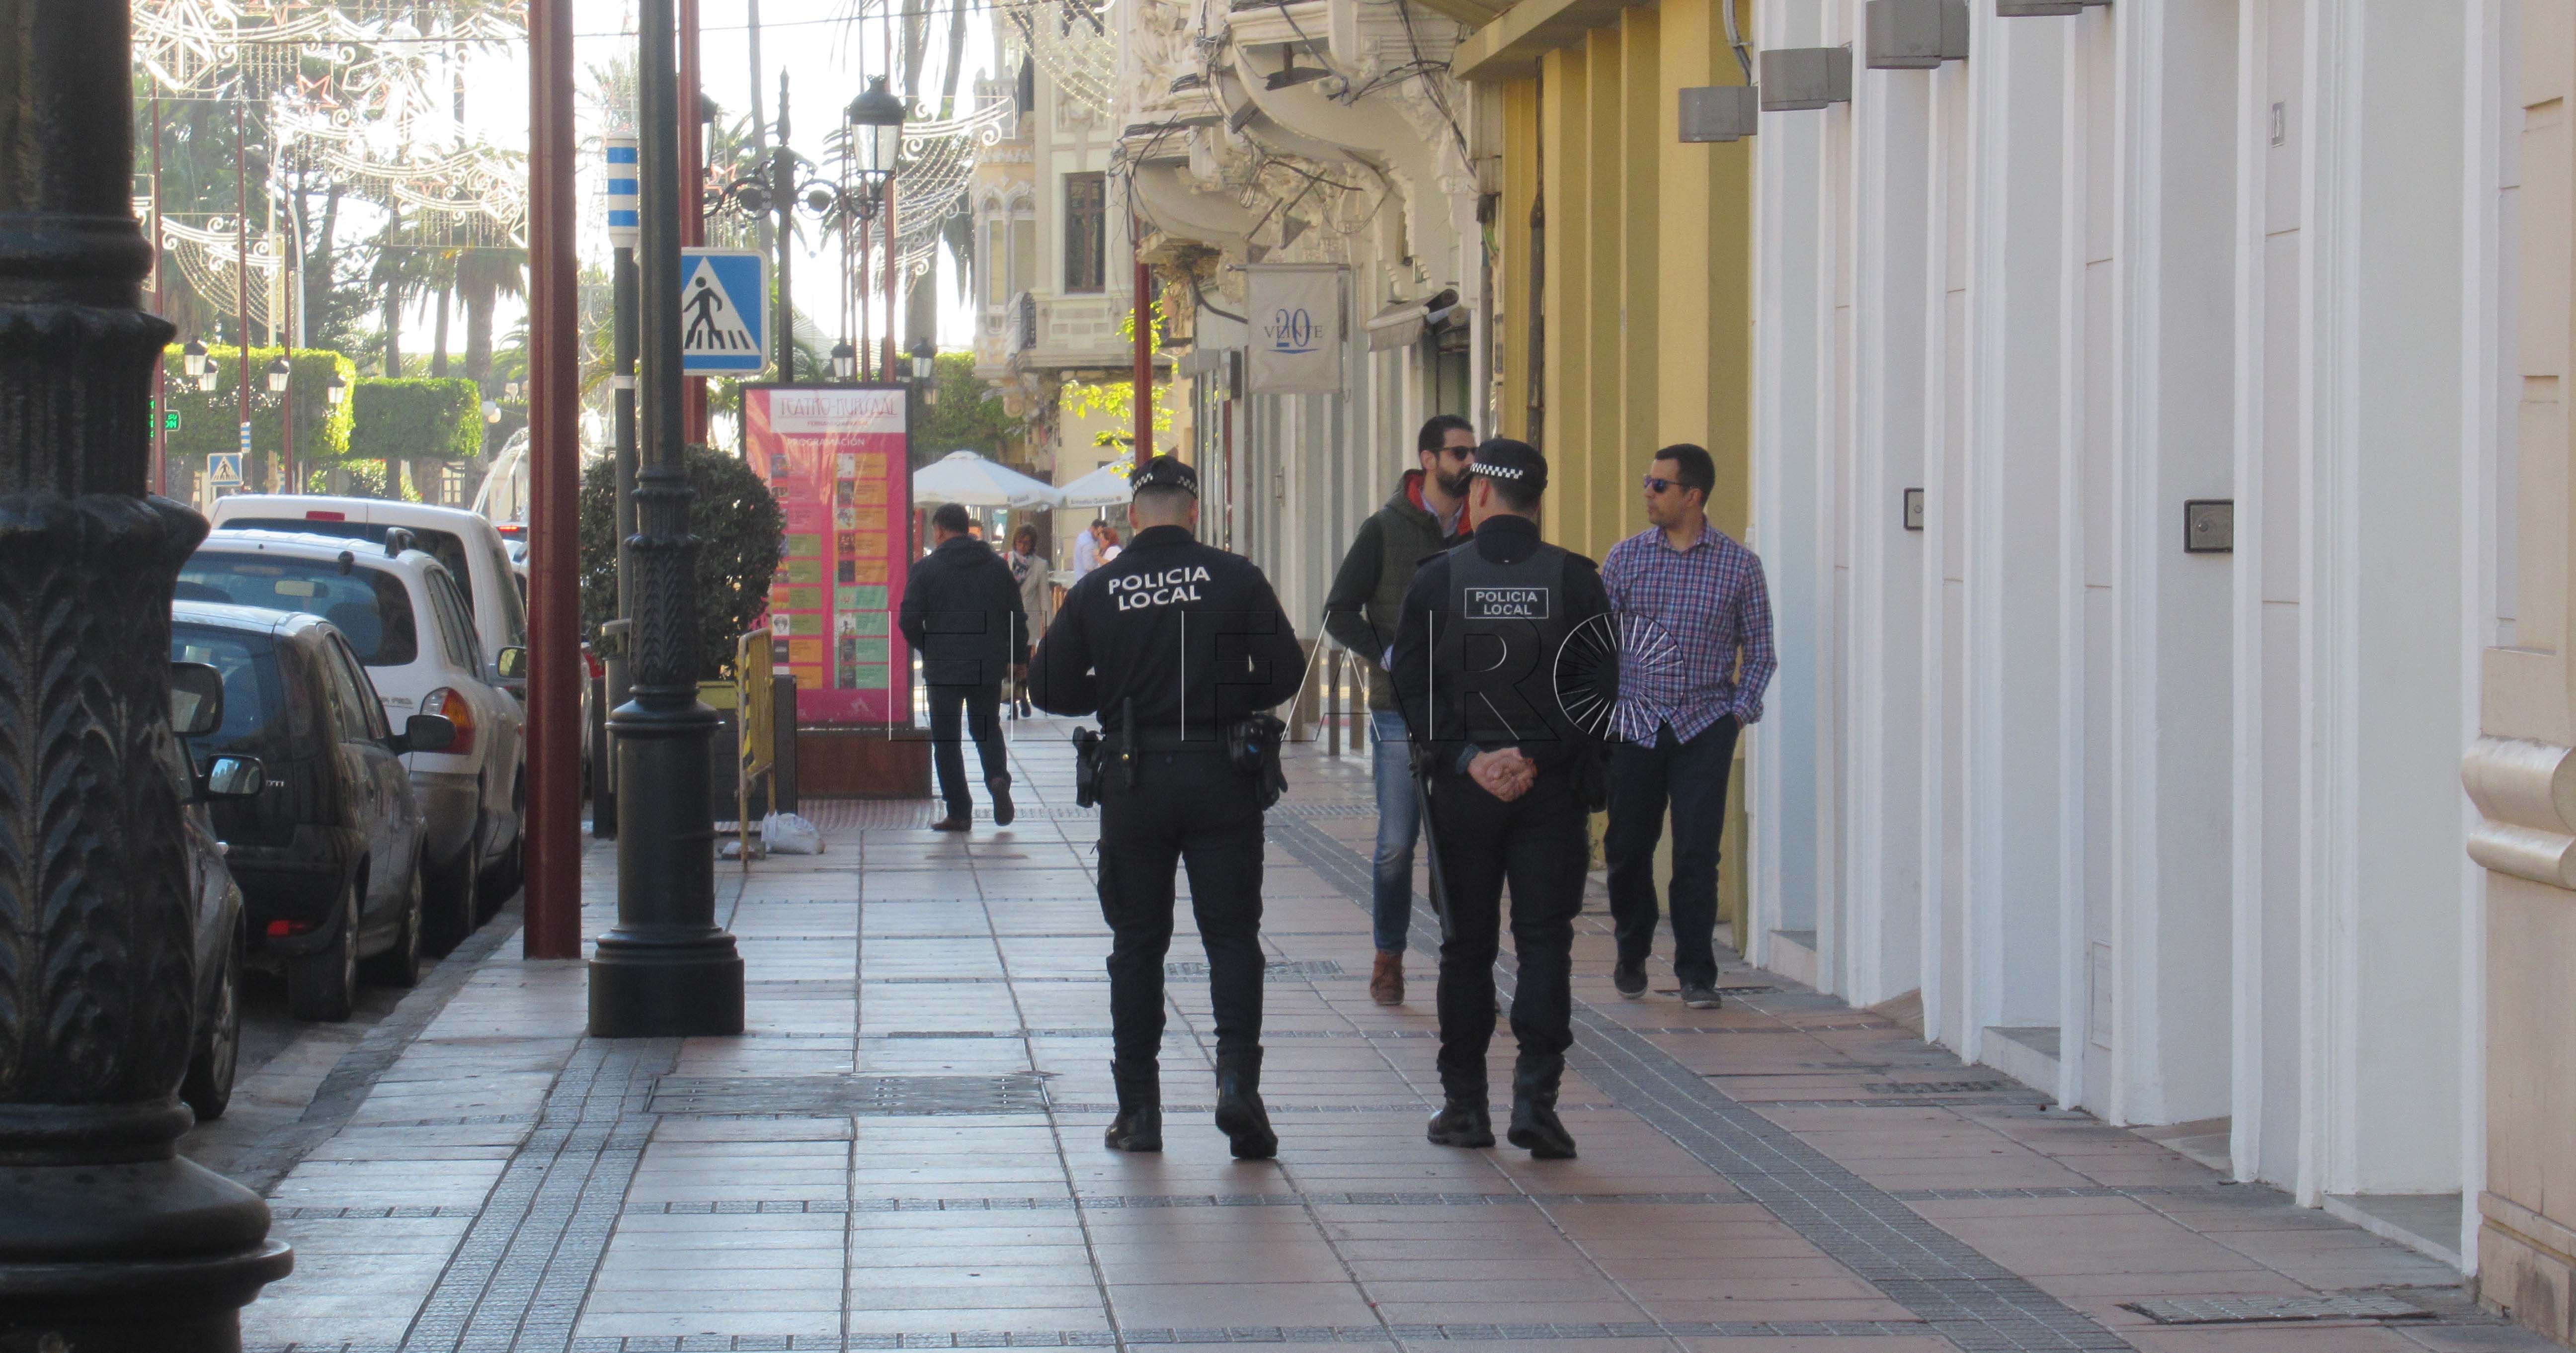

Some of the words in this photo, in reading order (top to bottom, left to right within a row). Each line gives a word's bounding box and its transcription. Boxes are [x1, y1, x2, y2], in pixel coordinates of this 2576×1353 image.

[1276, 308, 1310, 347] 20
[1108, 566, 1211, 595] POLICIA
[1119, 585, 1202, 611] LOCAL
[1475, 591, 1538, 602] POLICIA
[1483, 604, 1532, 615] LOCAL
